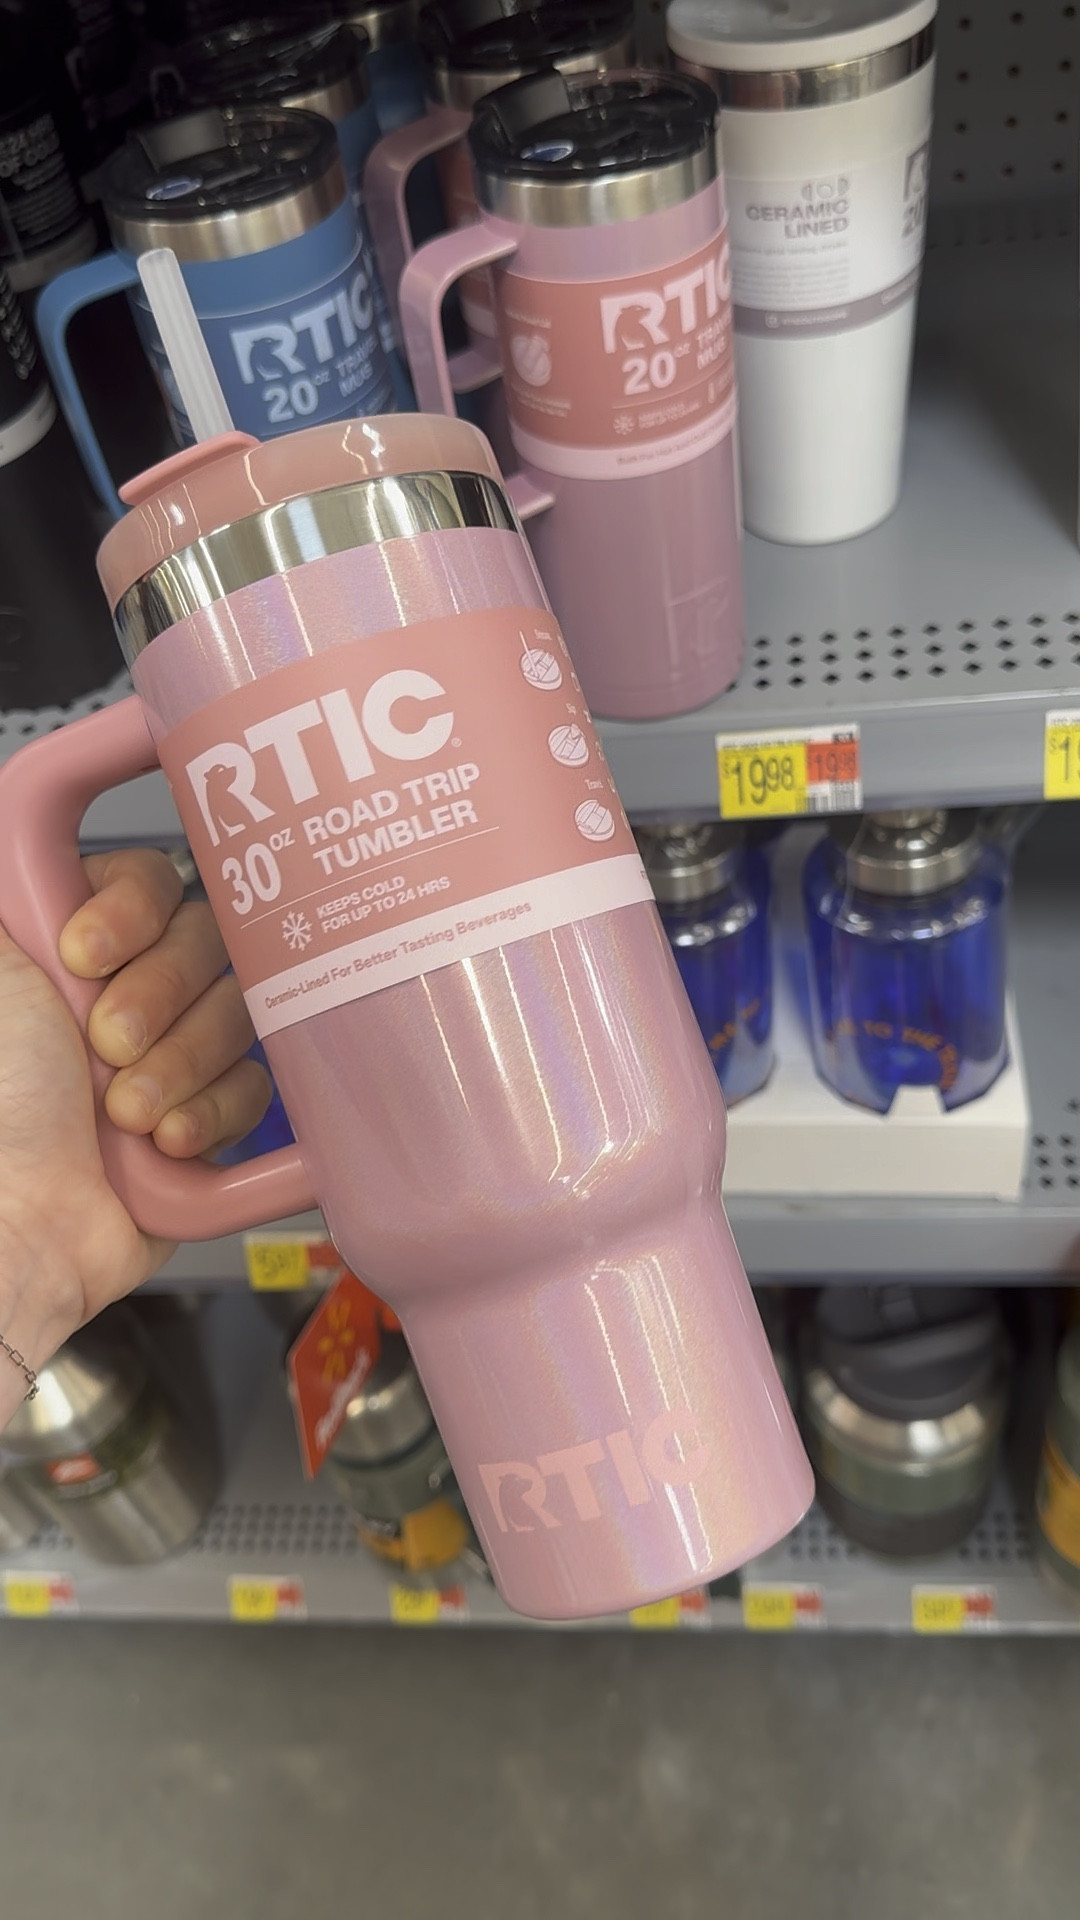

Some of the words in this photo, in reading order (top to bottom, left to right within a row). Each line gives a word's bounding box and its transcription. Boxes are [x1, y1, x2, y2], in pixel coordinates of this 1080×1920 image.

[745, 199, 849, 222] CERAMIC
[784, 217, 849, 239] LINED
[230, 273, 373, 384] RTIC
[262, 378, 318, 423] 20
[622, 351, 676, 395] 20
[185, 669, 455, 847] RTIC
[221, 843, 282, 916] 30
[302, 789, 400, 845] ROAD
[401, 763, 480, 807] TRIP
[312, 799, 479, 876] TUMBLER
[316, 890, 362, 919] KEEPS
[361, 875, 406, 901] COLD
[321, 913, 351, 934] FOR
[350, 905, 373, 922] UP
[374, 896, 396, 914] TO
[397, 889, 417, 906] 24
[417, 876, 451, 899] HRS
[264, 970, 331, 1010] Ceramic-Lined
[330, 965, 353, 984] For
[353, 944, 399, 973] Better
[398, 926, 455, 955] Tasting
[455, 901, 533, 934] Beverages
[477, 1408, 712, 1533] RTIC
